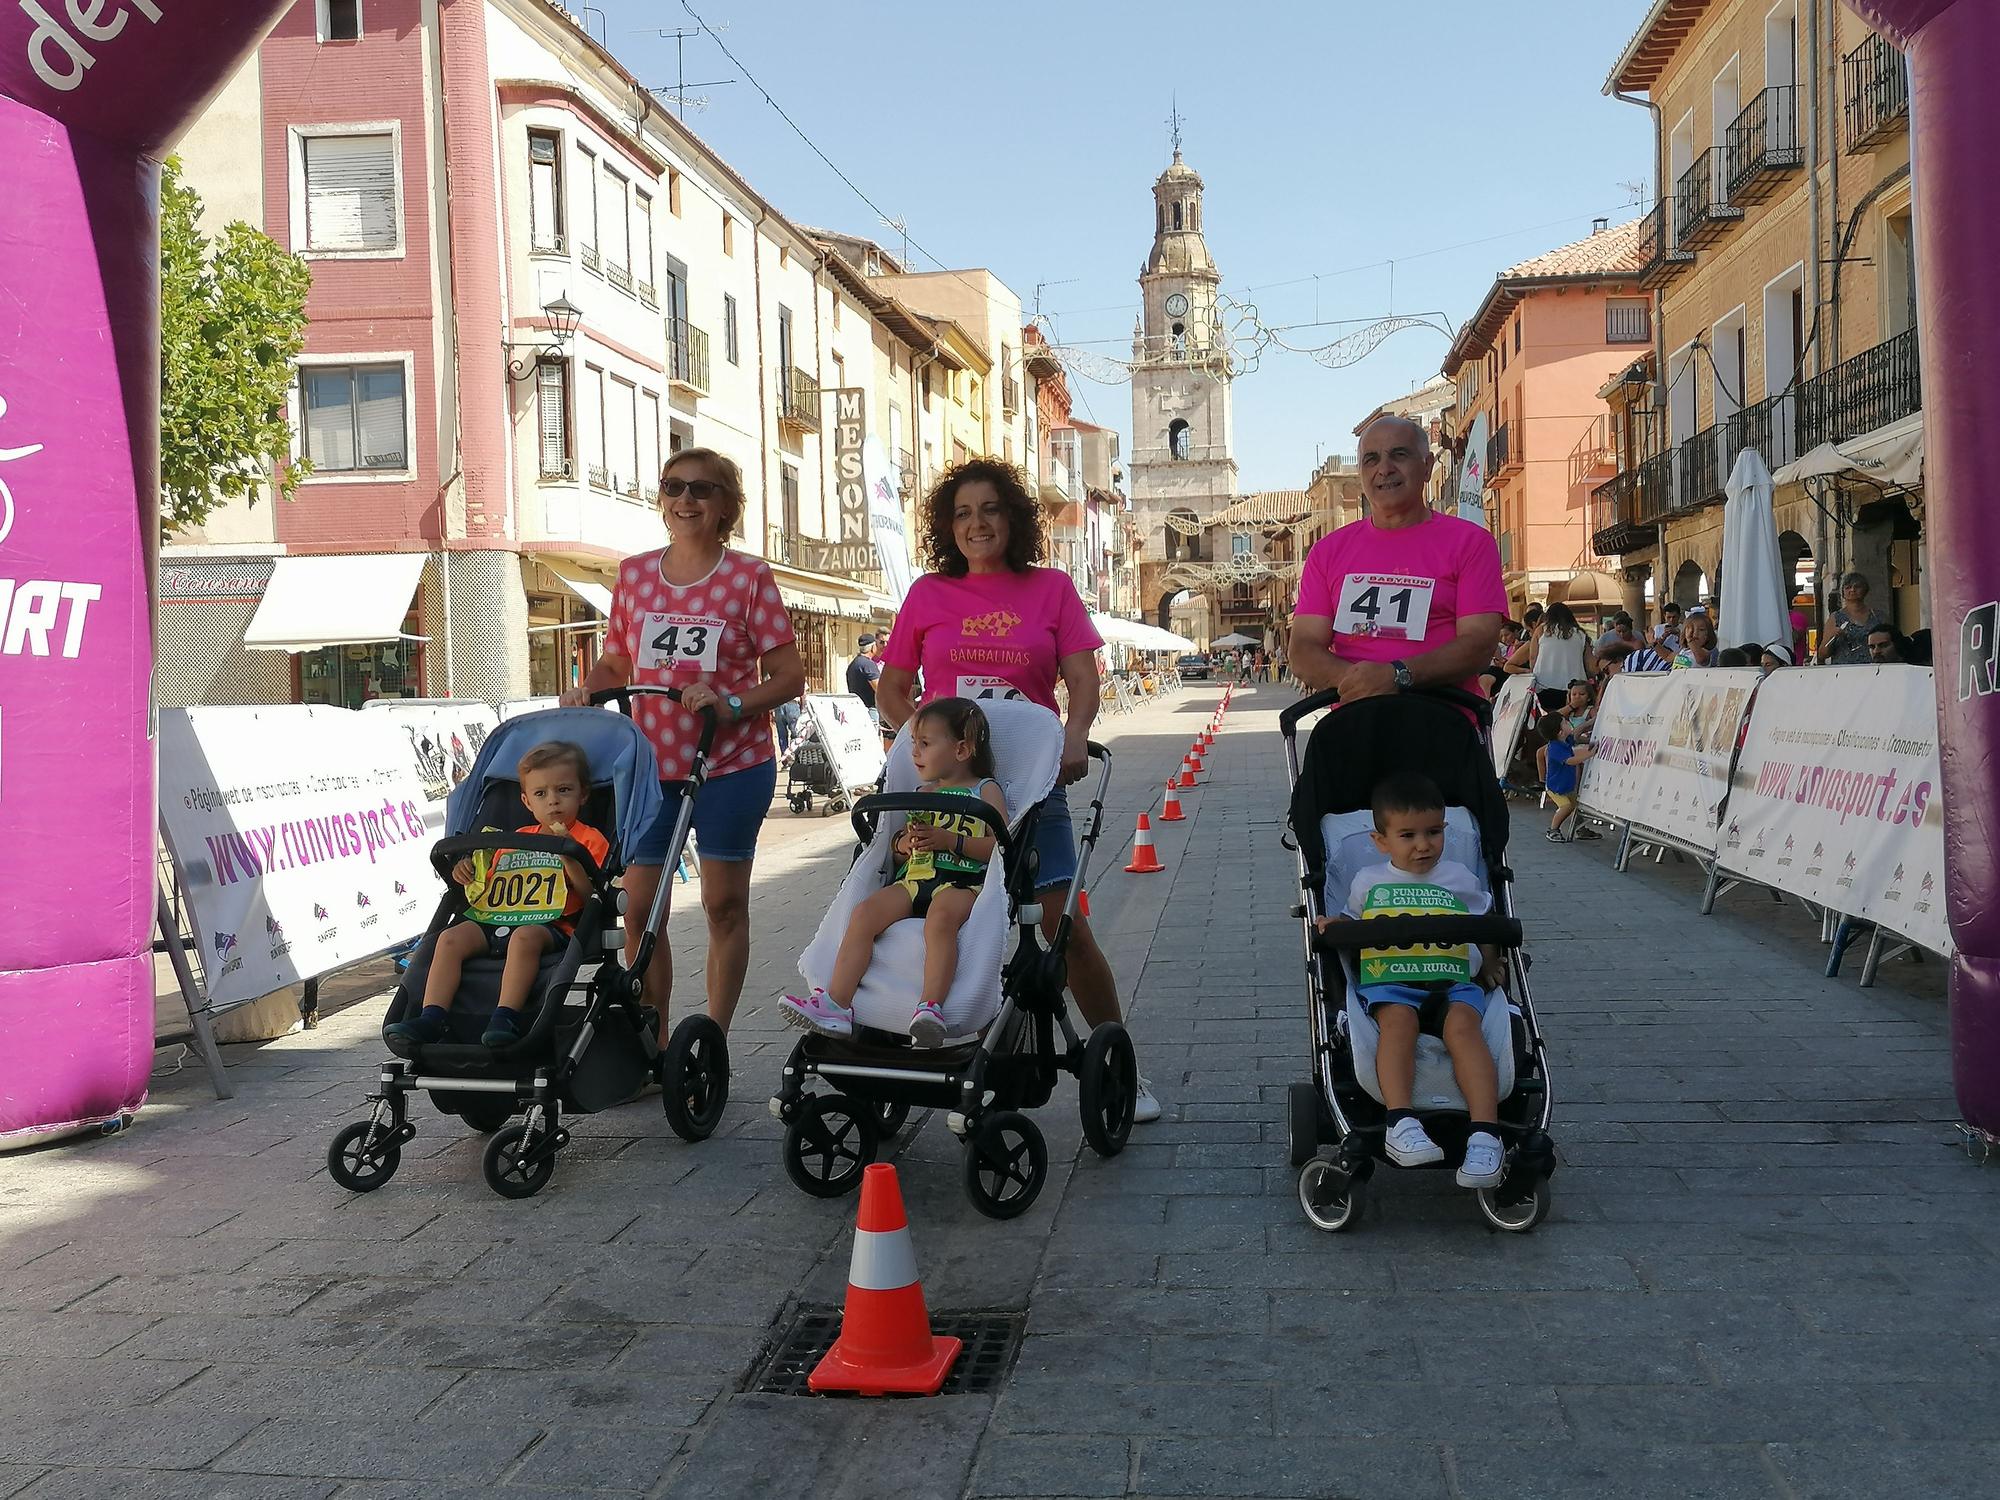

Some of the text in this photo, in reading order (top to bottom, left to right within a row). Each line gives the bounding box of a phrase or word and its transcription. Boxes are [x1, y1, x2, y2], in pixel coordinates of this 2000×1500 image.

[19, 0, 164, 91] de
[839, 393, 863, 540] MESON
[1369, 575, 1430, 586] BABYRUN
[0, 578, 102, 659] RT
[1350, 586, 1412, 623] 41
[651, 625, 708, 656] 43
[1959, 600, 2000, 702] R
[949, 648, 1031, 667] BAMBALINAS
[530, 858, 561, 868] RURAL
[488, 872, 557, 908] 0021
[1392, 897, 1456, 907] CAJA RURAL
[519, 912, 555, 922] RURAL
[1390, 962, 1465, 975] CAJA RURAL
